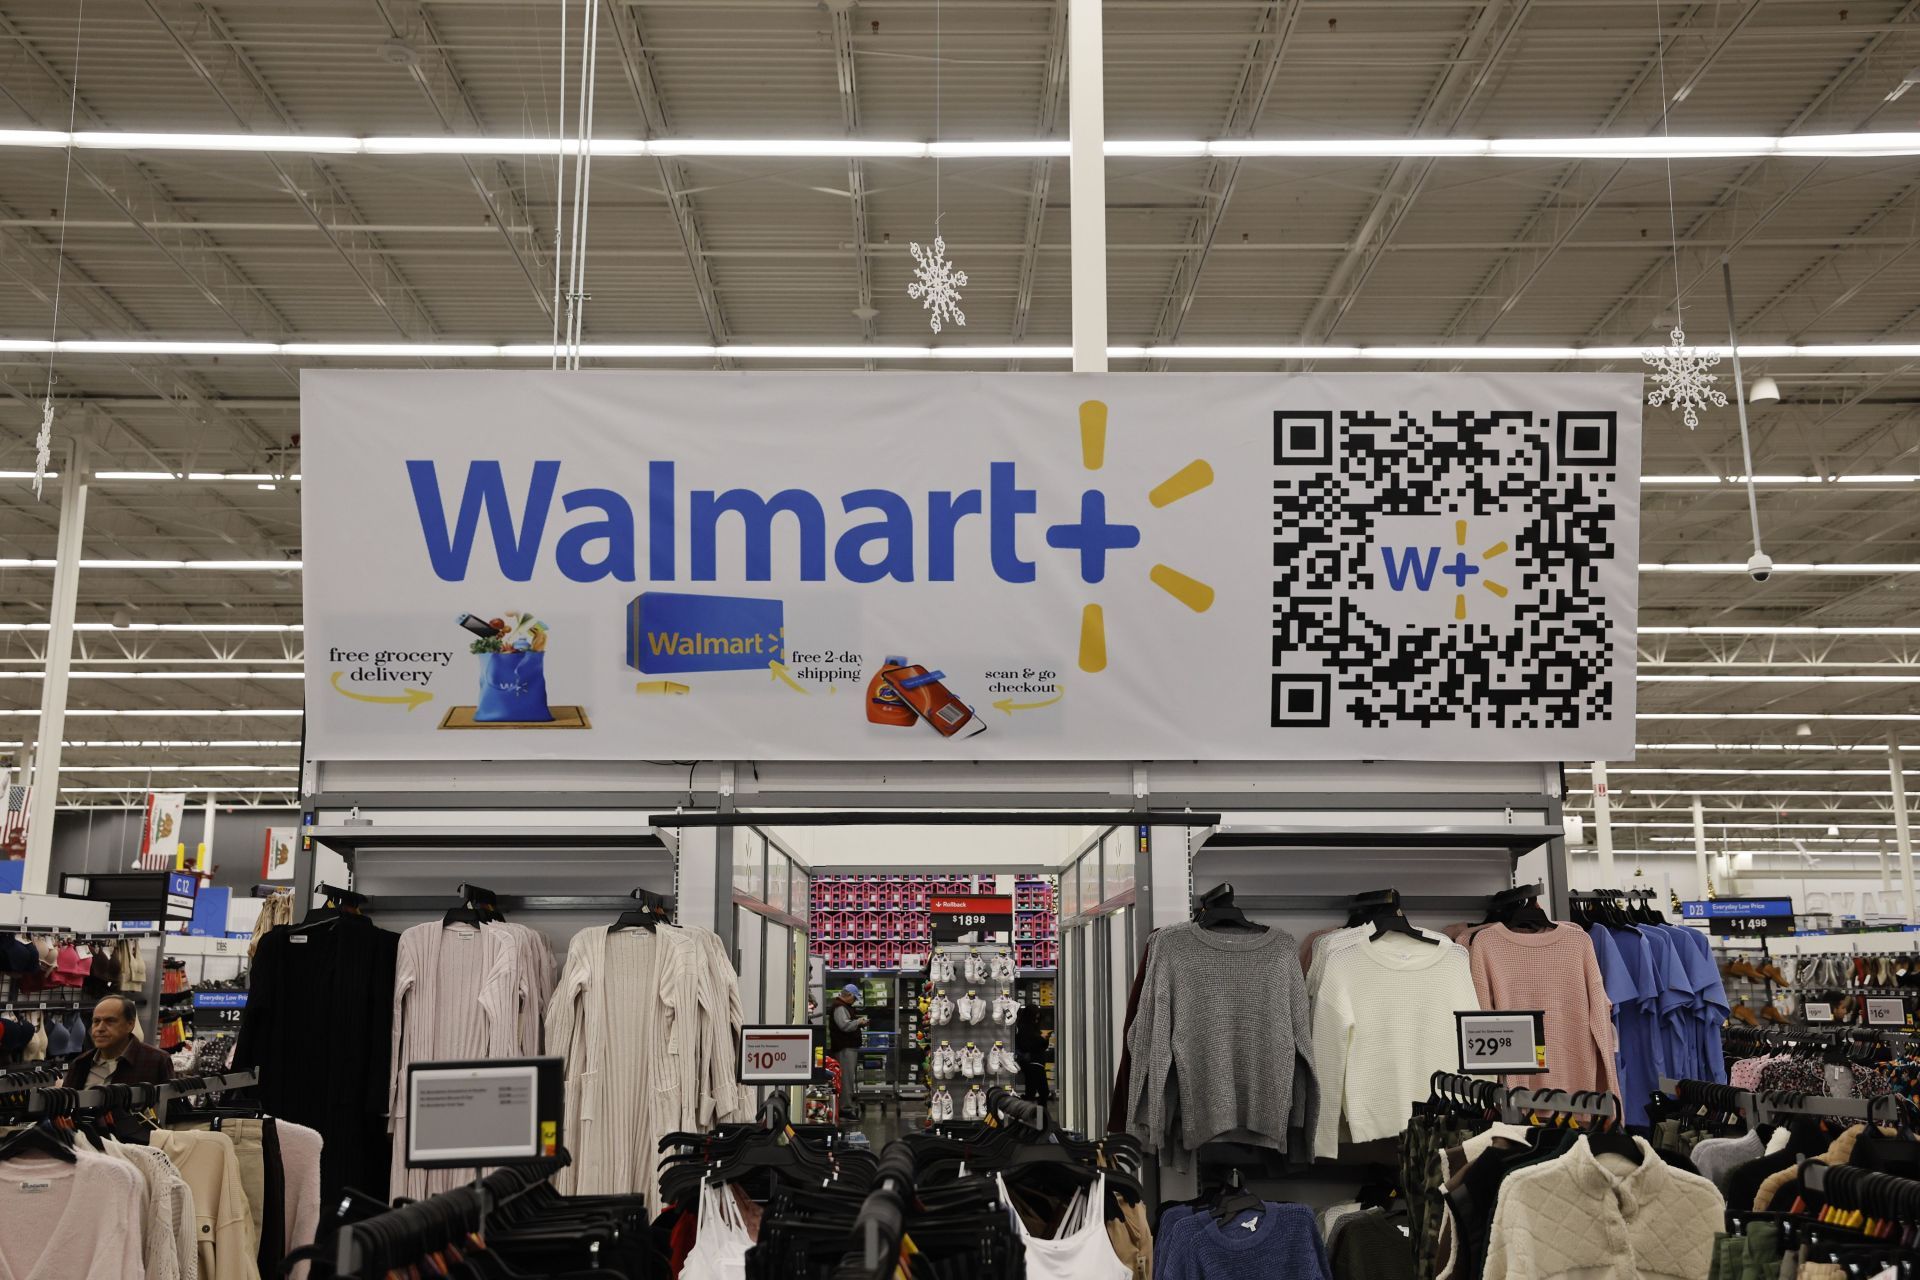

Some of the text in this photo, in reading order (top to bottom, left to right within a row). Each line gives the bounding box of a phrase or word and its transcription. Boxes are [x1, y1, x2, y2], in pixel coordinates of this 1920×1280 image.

[648, 632, 763, 656] Walmart
[329, 647, 453, 666] free grocery
[792, 650, 863, 667] free 2-day
[350, 667, 433, 686] delivery
[797, 666, 862, 682] shipping
[985, 668, 1056, 682] scan & go
[988, 682, 1056, 693] checkout
